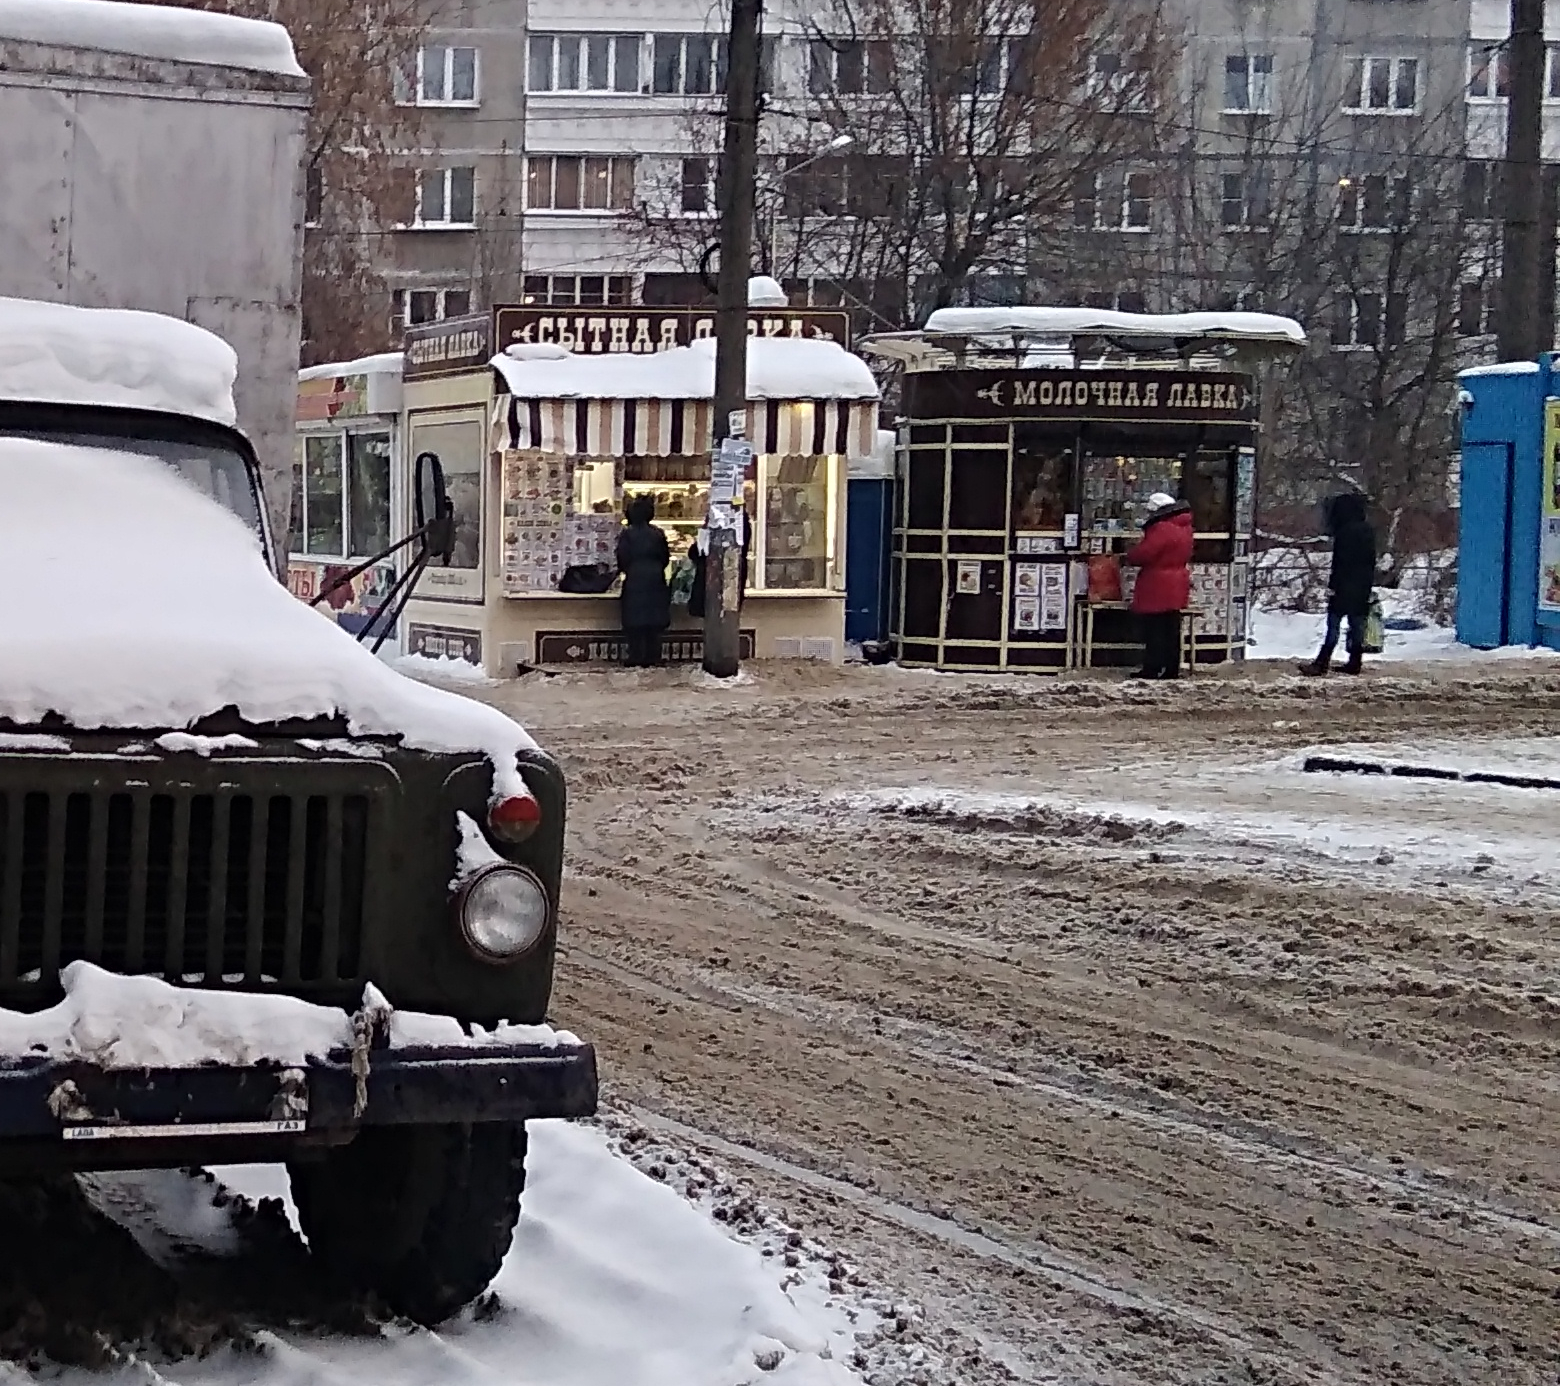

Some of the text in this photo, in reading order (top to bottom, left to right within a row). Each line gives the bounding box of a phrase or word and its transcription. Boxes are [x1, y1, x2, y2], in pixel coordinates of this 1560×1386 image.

[539, 317, 679, 352] СЫТНАЯ
[1013, 381, 1238, 409] МОЛОЧНАЯ ЛАВКА
